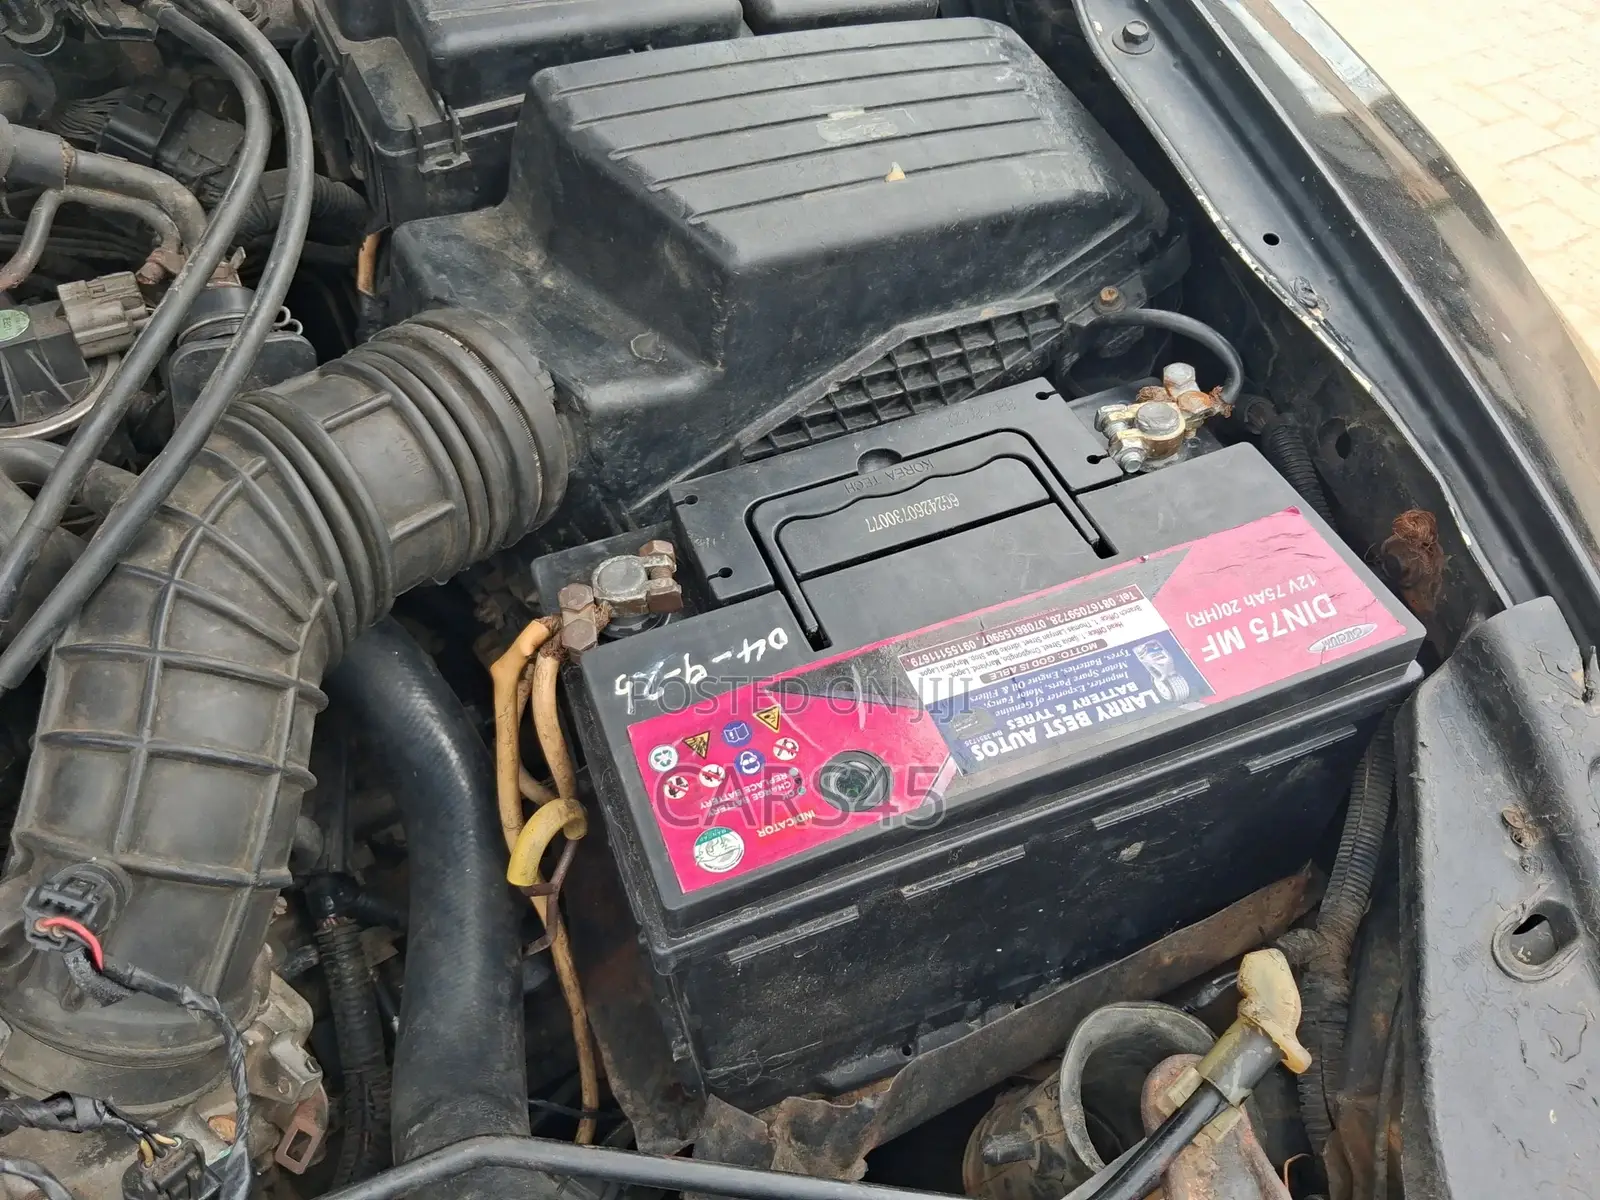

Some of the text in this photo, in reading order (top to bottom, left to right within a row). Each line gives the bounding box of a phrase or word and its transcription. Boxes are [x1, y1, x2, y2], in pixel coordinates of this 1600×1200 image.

[844, 459, 935, 494] KOREA TECH
[1116, 591, 1138, 602] Tel:
[1184, 573, 1317, 629] 12V 75Ah 20(HR)
[1200, 592, 1338, 663] DIN75 MF
[989, 642, 1098, 680] MOTTO: GOD IS ABLE
[1073, 669, 1100, 682] Spare
[1100, 661, 1128, 674] Motor
[1001, 686, 1010, 694] &
[1012, 681, 1027, 691] Oil
[1017, 686, 1044, 700] Motor
[1028, 671, 1060, 684] Engine
[969, 689, 999, 701] Filters
[995, 671, 1129, 717] Importer, Exporter of Genuine
[1006, 681, 1139, 730] BATTERY & TYRES
[970, 689, 1161, 762] LARRY BEST AUTOS
[701, 772, 788, 809] REPLACE BATTERY
[708, 781, 792, 817] CHARGE BATTERY
[756, 810, 816, 837] INDICATOR
